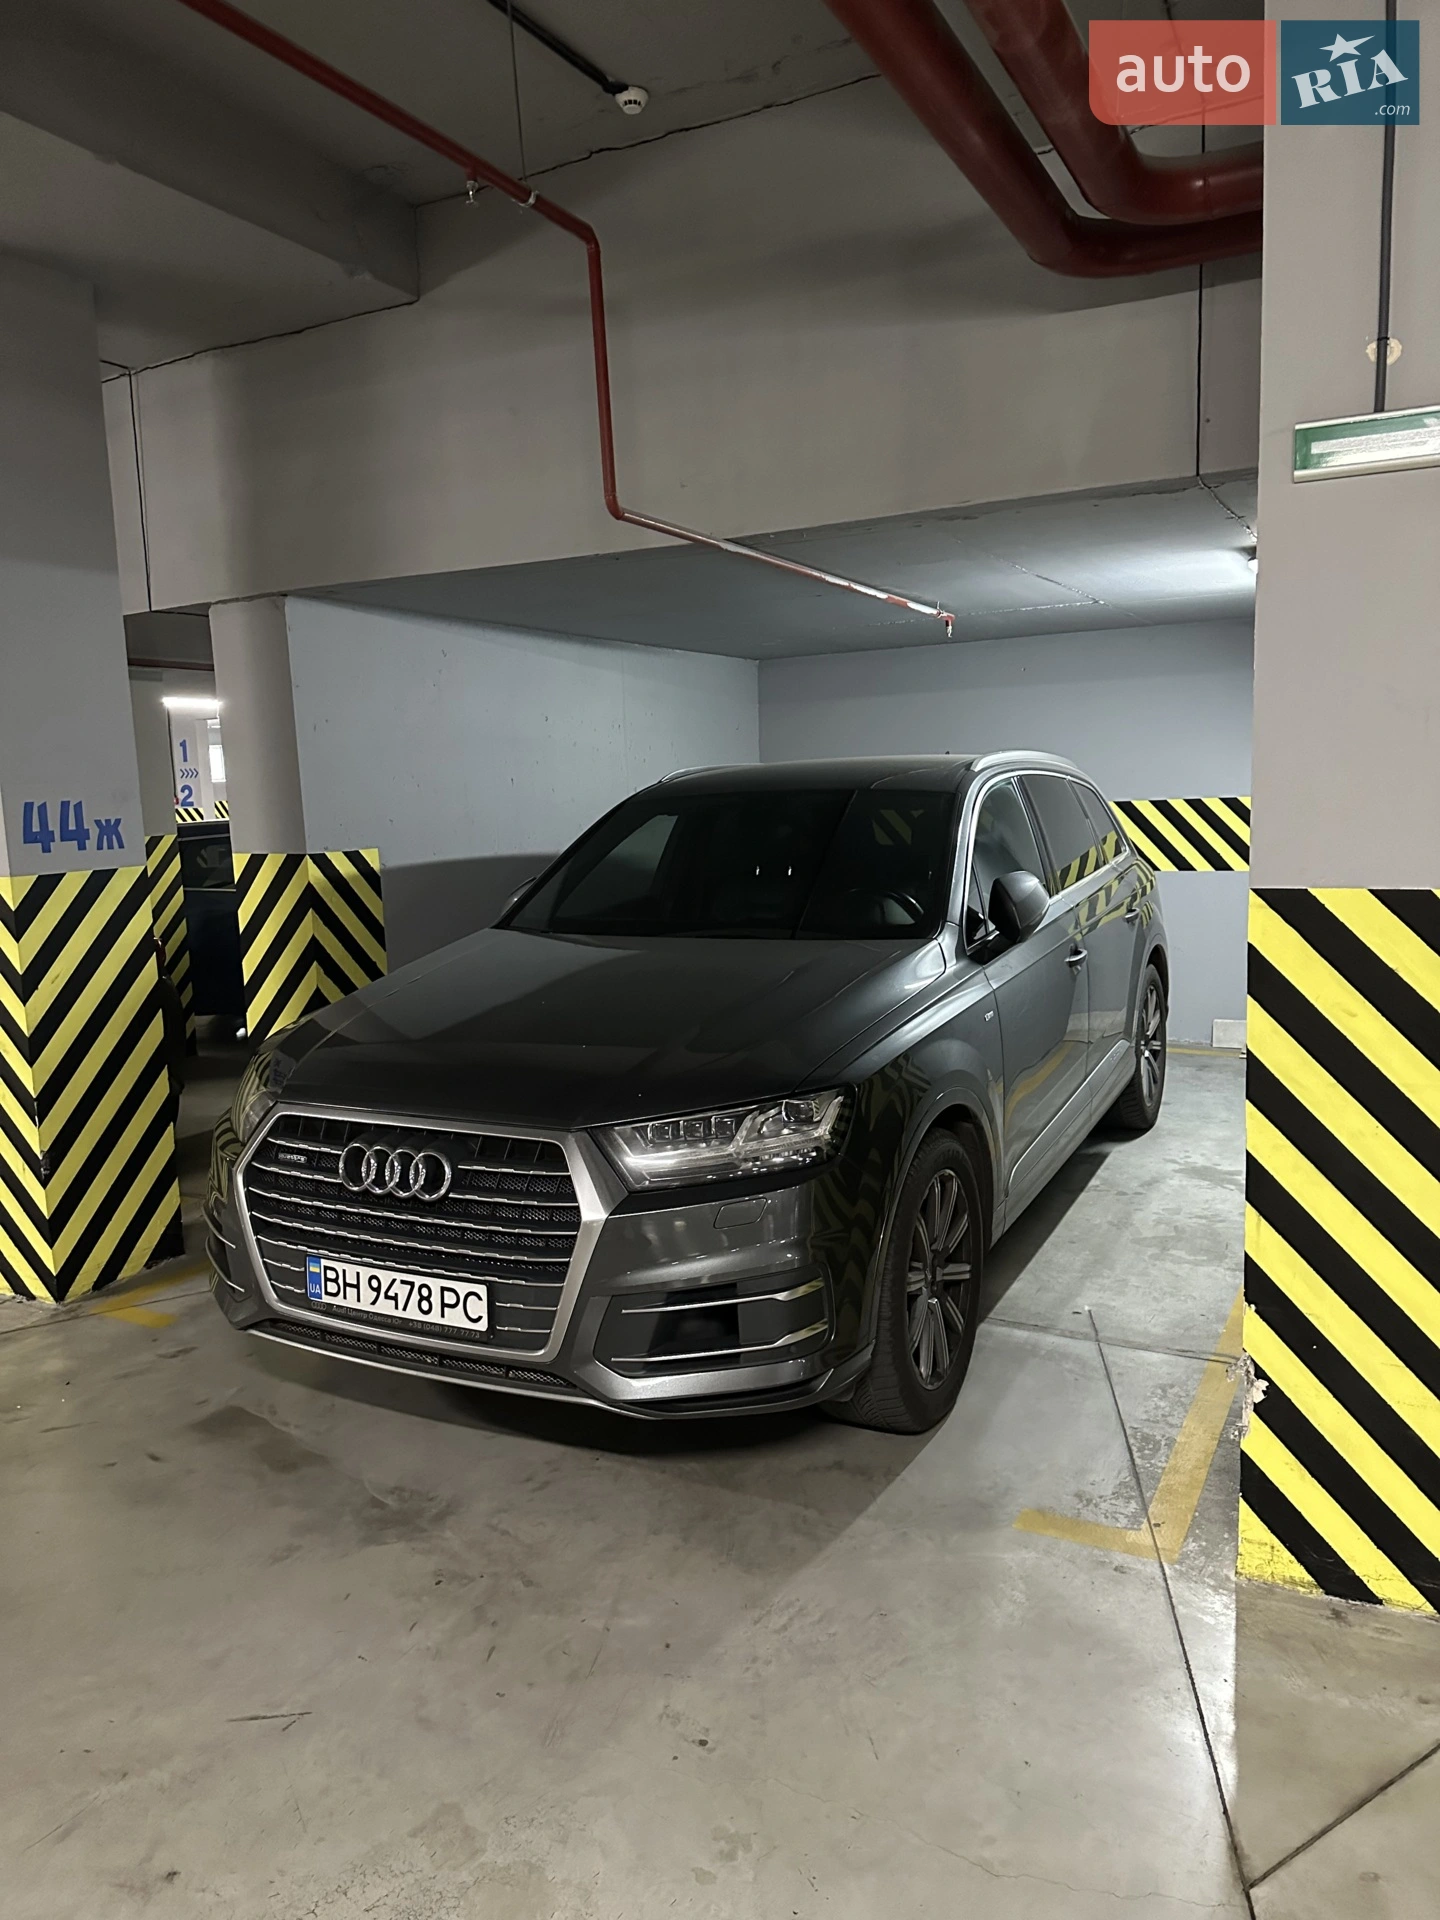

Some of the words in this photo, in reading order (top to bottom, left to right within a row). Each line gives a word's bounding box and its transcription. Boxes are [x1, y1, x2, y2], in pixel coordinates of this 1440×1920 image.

[179, 739, 188, 763] 1
[180, 784, 194, 807] 2
[309, 1283, 321, 1295] UA
[323, 1264, 361, 1303] BH
[367, 1274, 433, 1316] 9478
[440, 1285, 484, 1324] PC
[332, 1304, 347, 1314] Audi
[347, 1308, 367, 1320] Центр
[368, 1313, 391, 1323] Одесса
